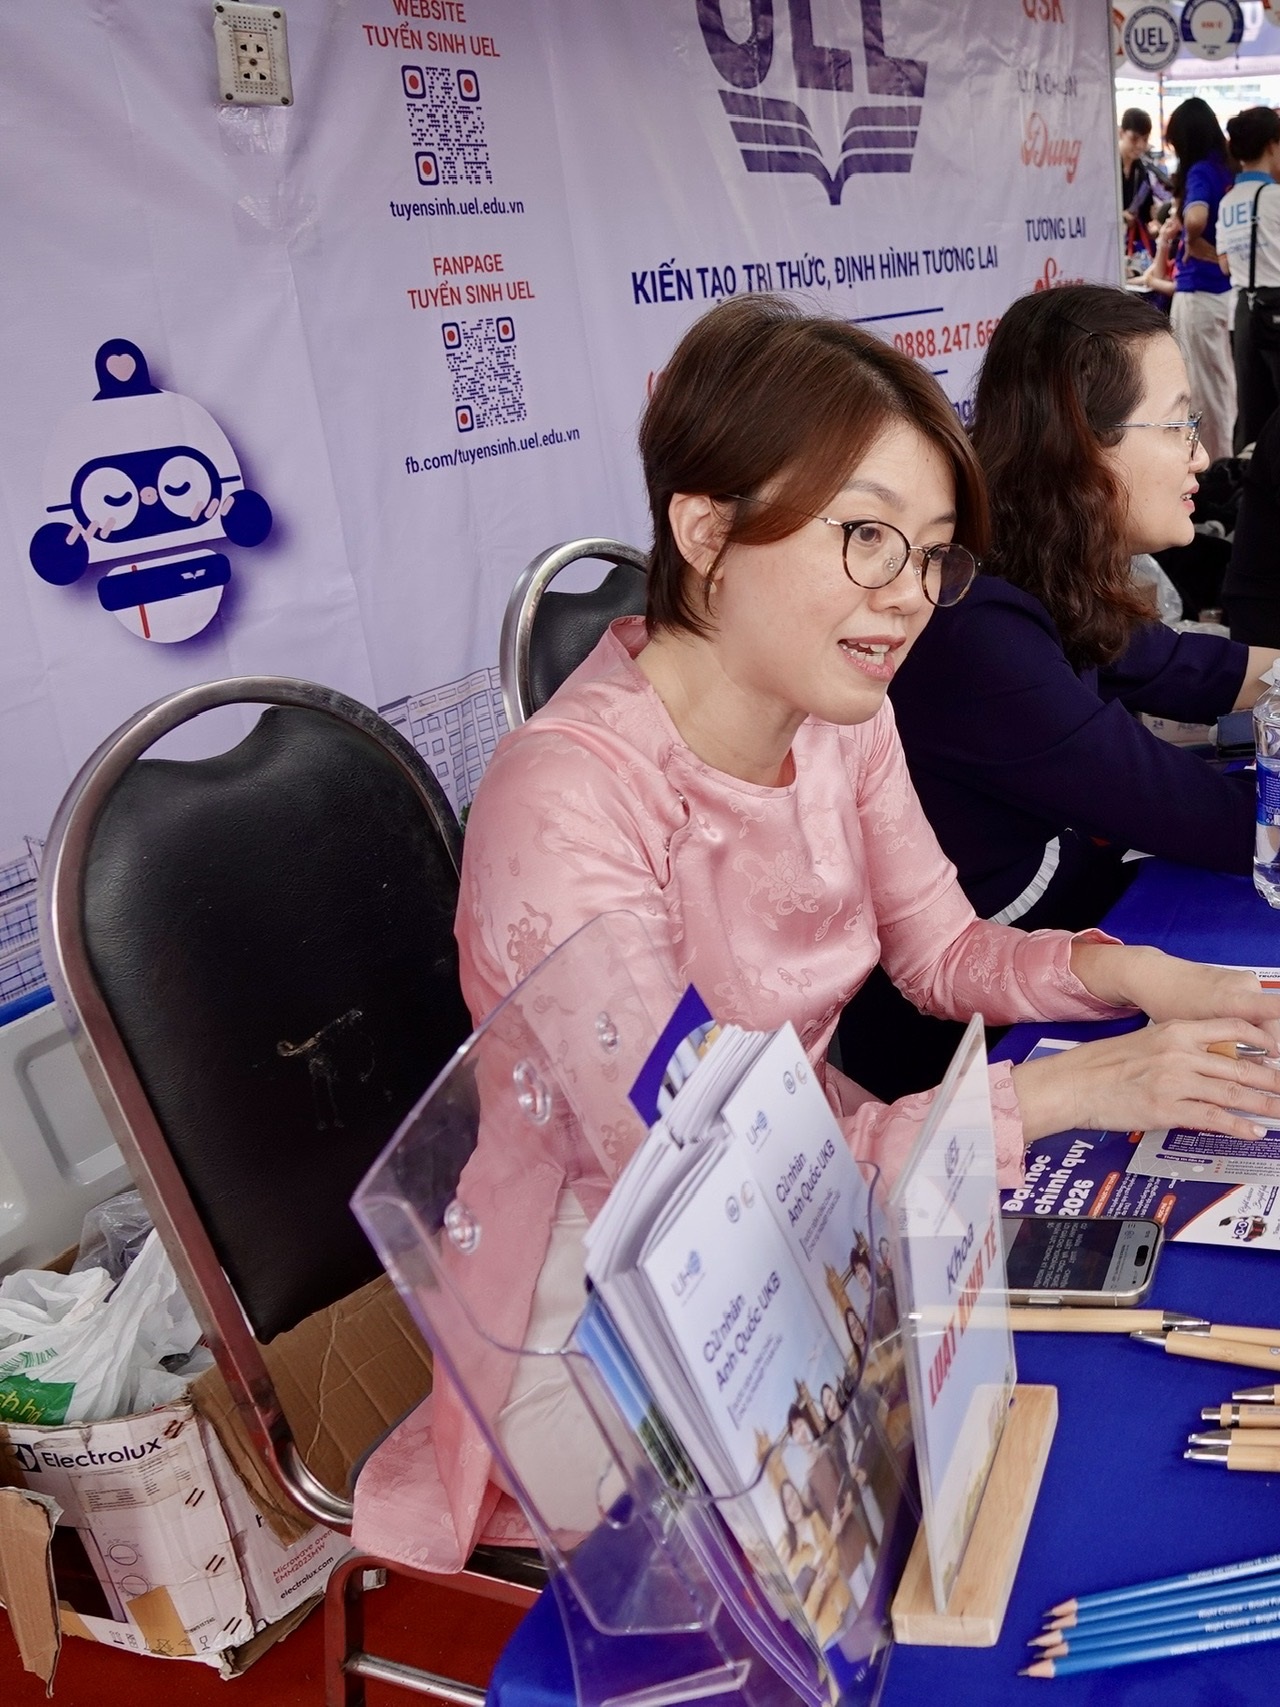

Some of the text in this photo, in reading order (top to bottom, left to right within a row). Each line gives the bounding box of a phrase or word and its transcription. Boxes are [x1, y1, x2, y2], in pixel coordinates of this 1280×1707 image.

[392, 0, 466, 23] WEBSITE
[362, 21, 501, 57] TUYỂN SINH UEL
[1134, 27, 1168, 46] UEL
[390, 197, 525, 221] tuyensinh.uel.edu.vn
[1025, 216, 1087, 242] TƯƠNG LAI
[1222, 200, 1254, 228] UE
[433, 254, 504, 276] FANPAGE
[631, 245, 999, 305] KIẾN TẠO TRI THỨC, ĐỊNH HÌNH TƯƠNG LAI
[407, 280, 535, 309] TUYỂN SINH UEL
[405, 426, 580, 474] fb.com/tuyensinh.uel.edu.vn
[787, 1196, 806, 1228] Anh
[816, 1139, 836, 1172] UKB
[1034, 1138, 1095, 1214] chính quy
[1058, 1179, 1094, 1217] 2026
[946, 1222, 974, 1295] Khoa
[957, 1248, 985, 1338] KINH
[714, 1350, 739, 1393] Anh
[733, 1305, 763, 1355] Quốc
[757, 1270, 782, 1311] UKB
[41, 1437, 162, 1469] Electrolux
[272, 1529, 333, 1577] Microwave oven
[275, 1542, 326, 1584] EMM2023MW
[280, 1556, 335, 1599] electrolux.com
